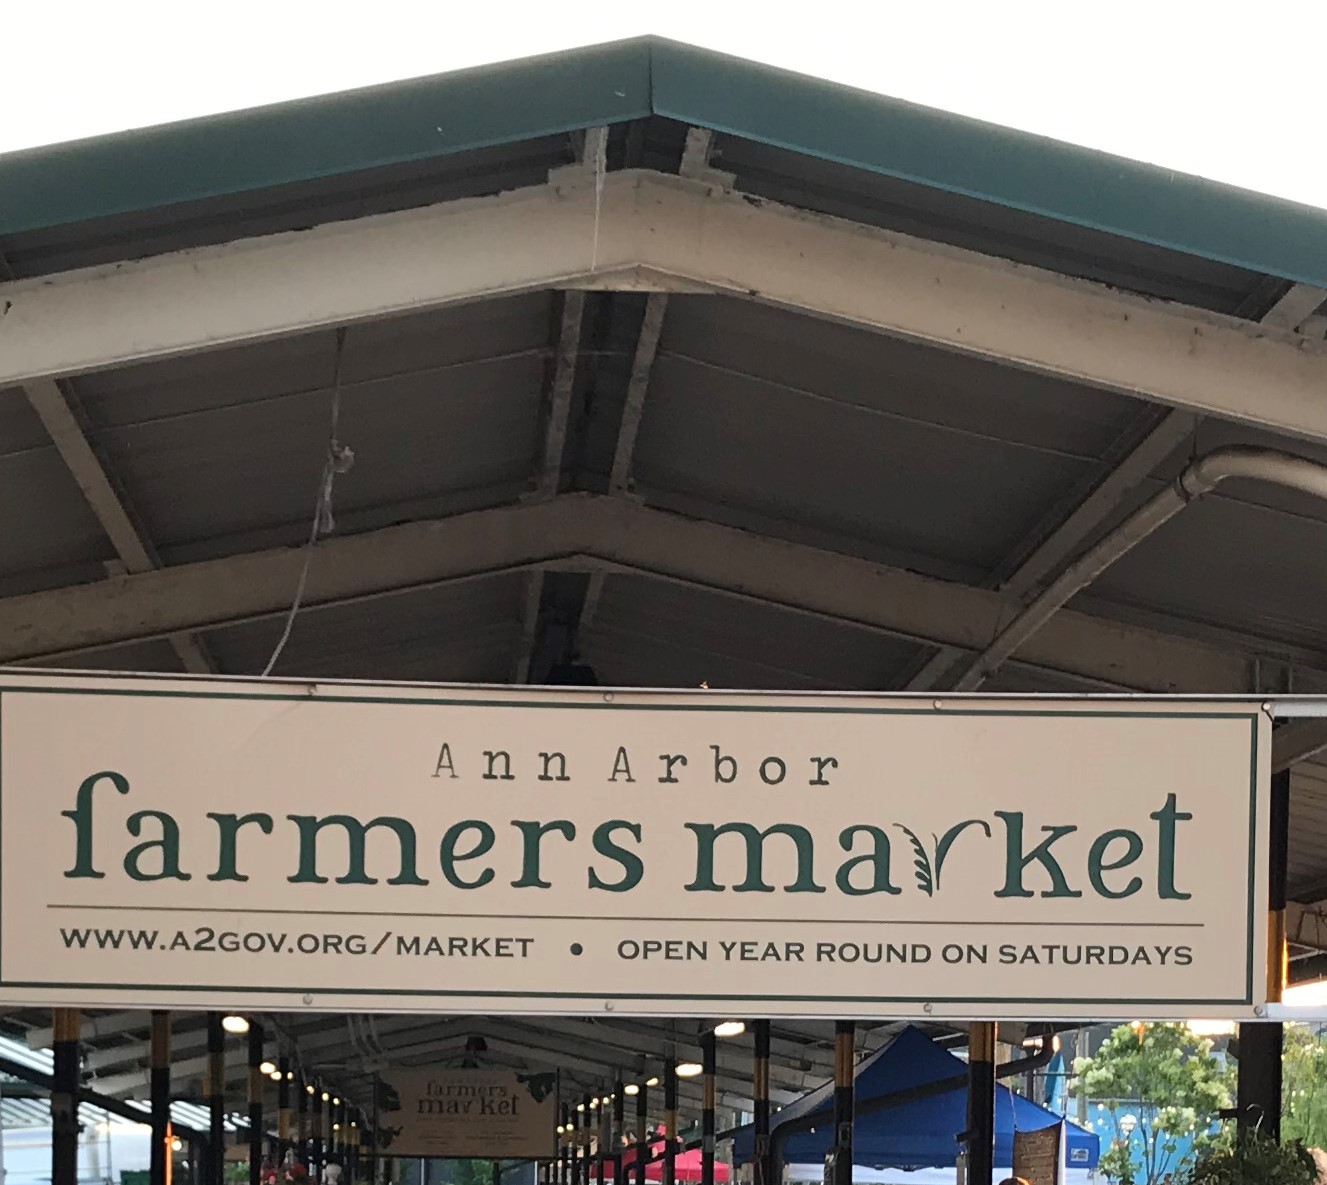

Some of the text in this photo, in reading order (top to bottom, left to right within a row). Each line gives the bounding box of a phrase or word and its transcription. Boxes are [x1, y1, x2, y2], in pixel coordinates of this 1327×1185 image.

[431, 742, 839, 787] Ann Arbor
[60, 770, 1194, 901] farmers market
[59, 926, 1194, 967] WWW.A2GOV.ORG/MARKET OPEN YEAR ROUND ON SATURDAYS
[417, 1094, 521, 1116] market
[426, 1080, 508, 1097] farmers
